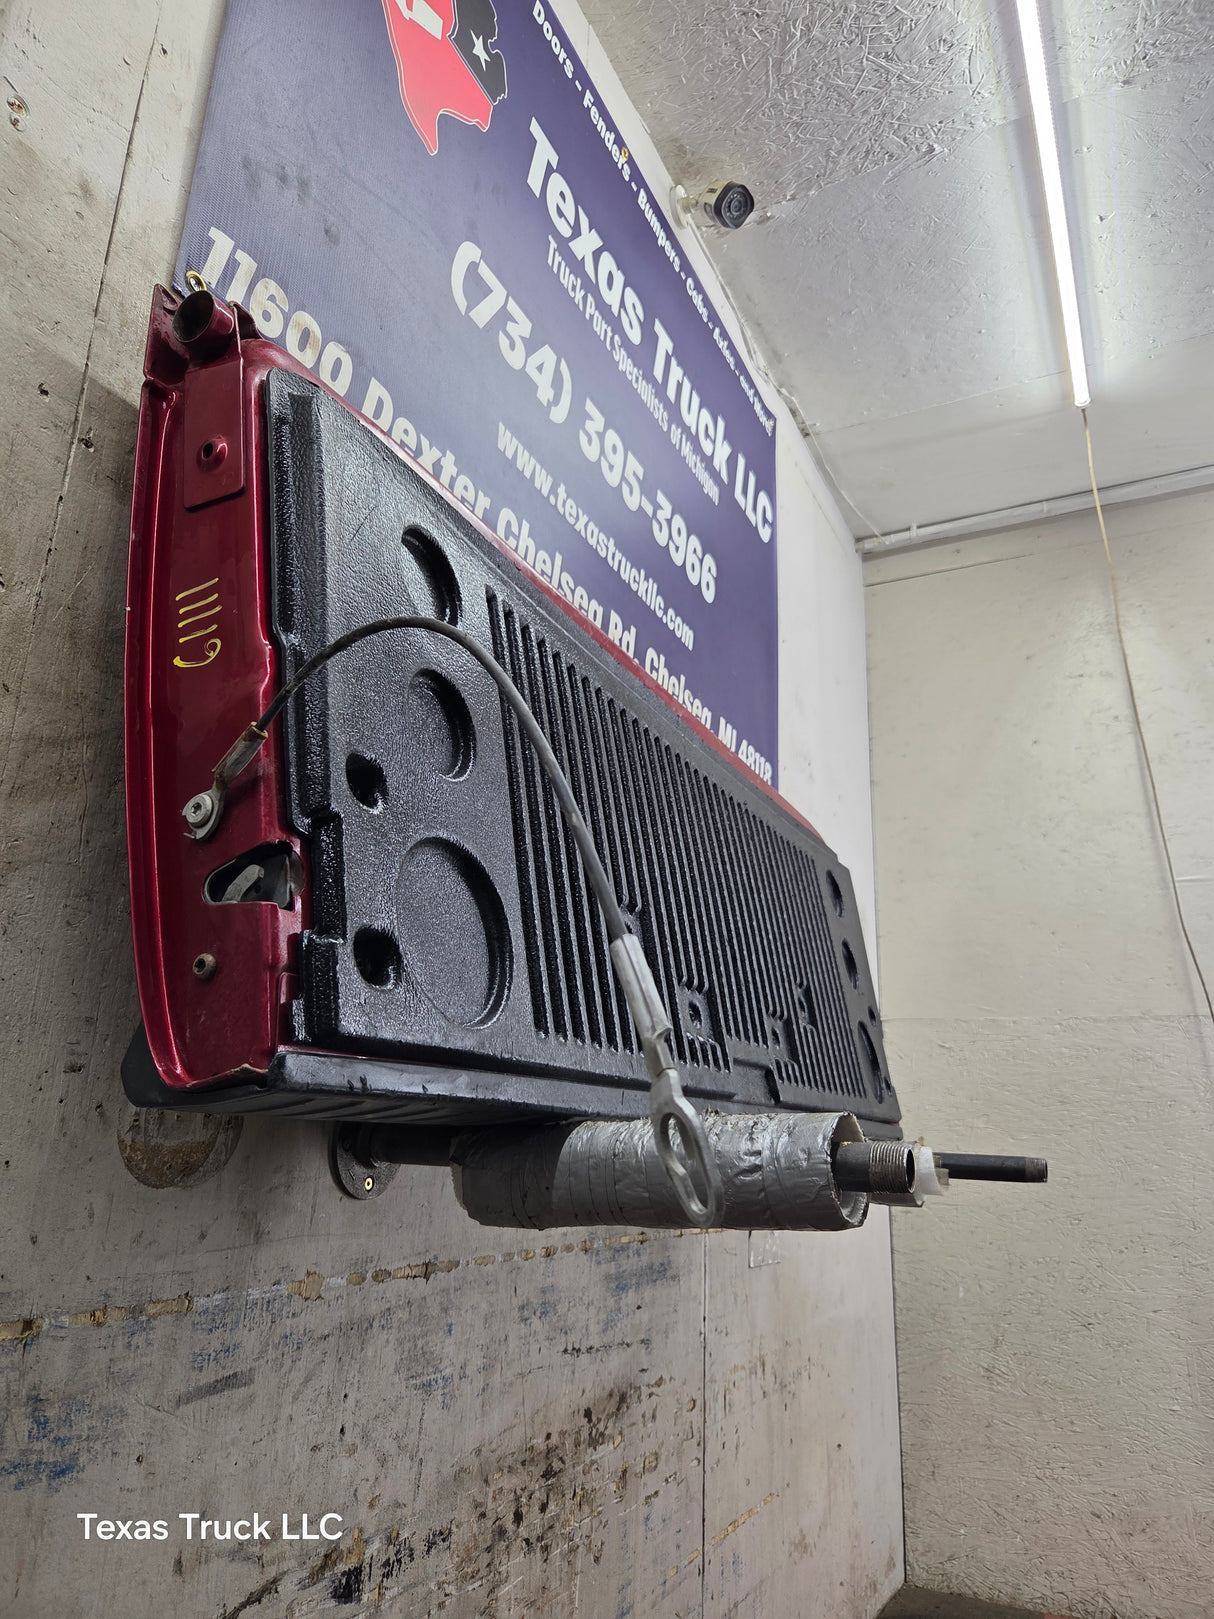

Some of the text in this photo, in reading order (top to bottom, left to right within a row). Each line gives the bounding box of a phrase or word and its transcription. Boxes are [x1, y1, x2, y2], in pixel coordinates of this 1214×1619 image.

[533, 0, 574, 79] Doors
[583, 89, 631, 181] Fenders
[638, 188, 681, 273] Bumpers
[450, 240, 718, 604] (734) 395-3966
[527, 117, 774, 543] Texas Truck LLC
[547, 235, 719, 506] Truck Part Specialists of Michigan
[200, 227, 353, 398] 11600
[361, 376, 491, 520] Dexter
[497, 508, 604, 628] Chelsea
[645, 647, 714, 733] Chelsea
[718, 716, 737, 752] MI
[738, 739, 773, 785] 48118
[497, 422, 695, 651] www.texastruckllc.com
